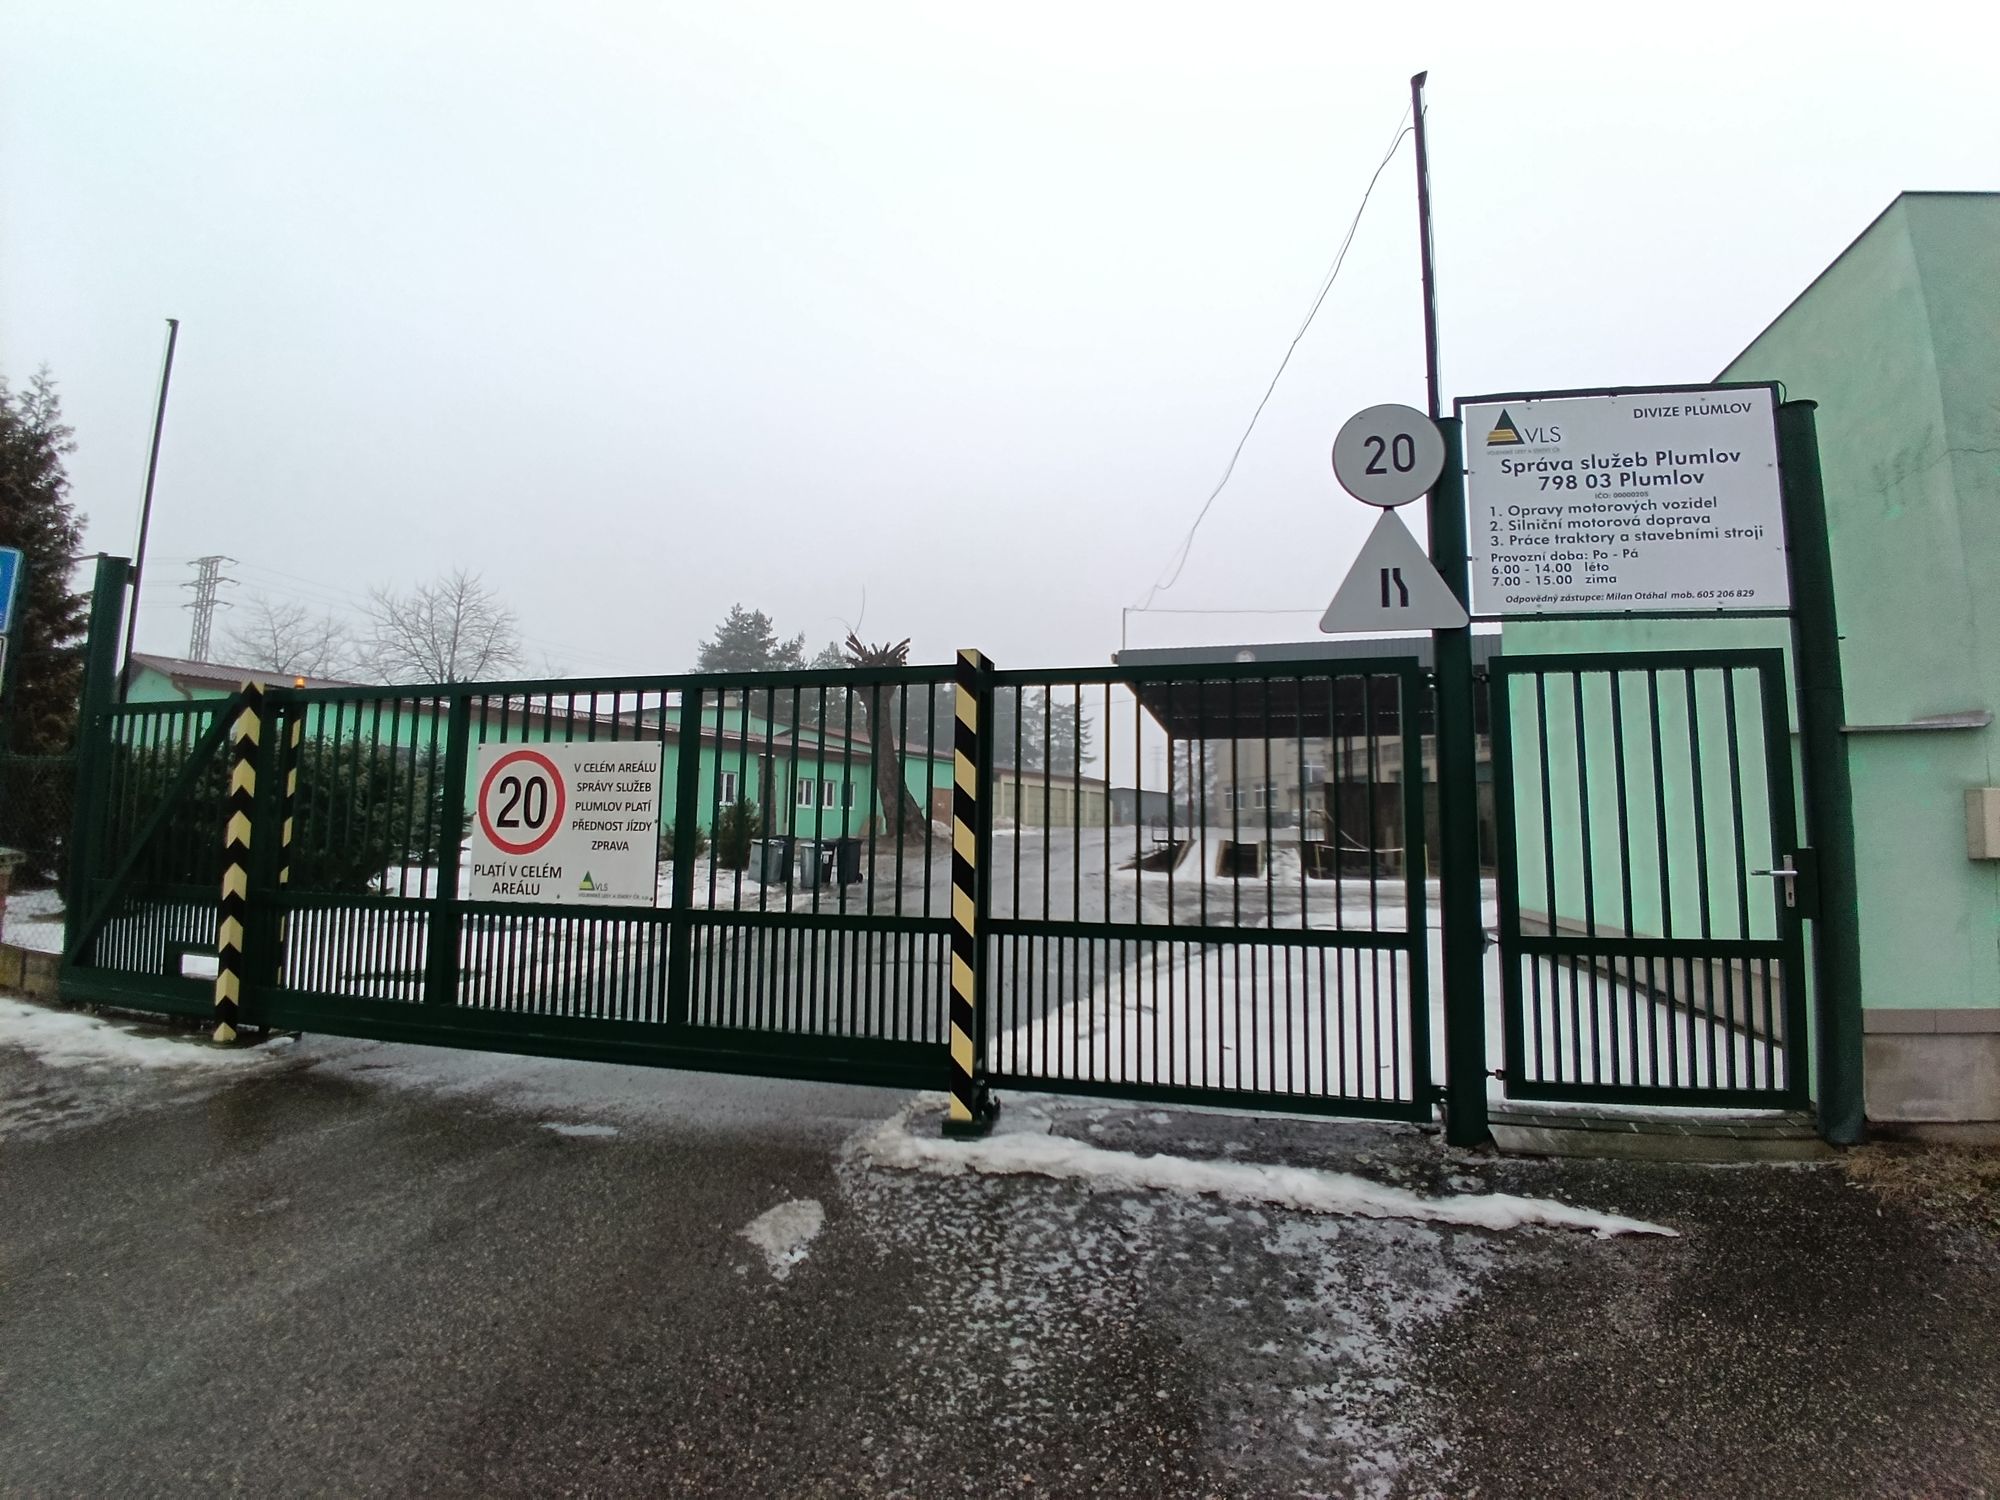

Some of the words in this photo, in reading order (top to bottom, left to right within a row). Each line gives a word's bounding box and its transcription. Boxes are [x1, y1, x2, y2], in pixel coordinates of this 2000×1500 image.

[1633, 406, 1680, 419] DIVIZE
[1685, 402, 1752, 417] PLUMLOV
[1524, 426, 1562, 443] VLS
[1363, 433, 1416, 475] 20
[1501, 457, 1573, 477] Správa
[1580, 451, 1648, 470] služeb
[1656, 450, 1741, 466] Plumlov
[1538, 474, 1578, 491] 798
[1585, 473, 1611, 489] 03
[1620, 471, 1705, 488] Plumlov
[1490, 505, 1503, 517] 1.
[1507, 504, 1563, 520] Opravy
[1567, 499, 1658, 515] motorových
[1662, 496, 1718, 510] vozidel
[1489, 521, 1503, 532] 2.
[1508, 517, 1563, 532] Silniční
[1567, 514, 1641, 529] motorová
[1646, 513, 1711, 529] doprava
[1490, 535, 1504, 547] 3.
[1509, 532, 1550, 546] Práce
[1554, 529, 1615, 546] traktory
[1620, 534, 1630, 543] a
[1634, 527, 1719, 542] stavebními
[1724, 525, 1763, 540] stroji
[1491, 551, 1546, 563] Provozní
[1550, 549, 1588, 561] doba:
[1592, 549, 1608, 560] Po
[1622, 547, 1639, 559] Pá
[1491, 564, 1520, 575] 6.00
[1535, 563, 1572, 574] 14.00
[1584, 561, 1610, 572] léto
[1492, 576, 1521, 587] 7.00
[1535, 575, 1573, 586] 15.00
[1585, 574, 1617, 584] zima
[1505, 593, 1558, 604] Odpovědný
[1560, 592, 1604, 603] zástupce:
[1605, 592, 1633, 601] Milan
[1634, 591, 1667, 600] Otáhal
[1671, 590, 1695, 599] mob.
[1696, 590, 1715, 599] 605
[1717, 590, 1735, 598] 206
[1736, 589, 1755, 598] 829
[574, 763, 582, 773] V
[583, 760, 615, 773] CELÉM
[617, 760, 657, 773] AREÁLU
[576, 780, 614, 793] SPRÁVY
[615, 780, 652, 793] SLUŽEB
[496, 776, 548, 830] 20
[575, 801, 622, 812] PLUMLOV
[624, 799, 652, 812] PLATÍ
[572, 819, 623, 831] PŘEDNOST
[625, 819, 652, 832] JÍZDY
[591, 840, 629, 852] ZPRAVA
[474, 862, 507, 877] PLATÍ
[508, 865, 518, 877] V
[520, 863, 562, 879] CELÉM
[492, 880, 540, 896] AREÁLU
[594, 882, 609, 892] VLS
